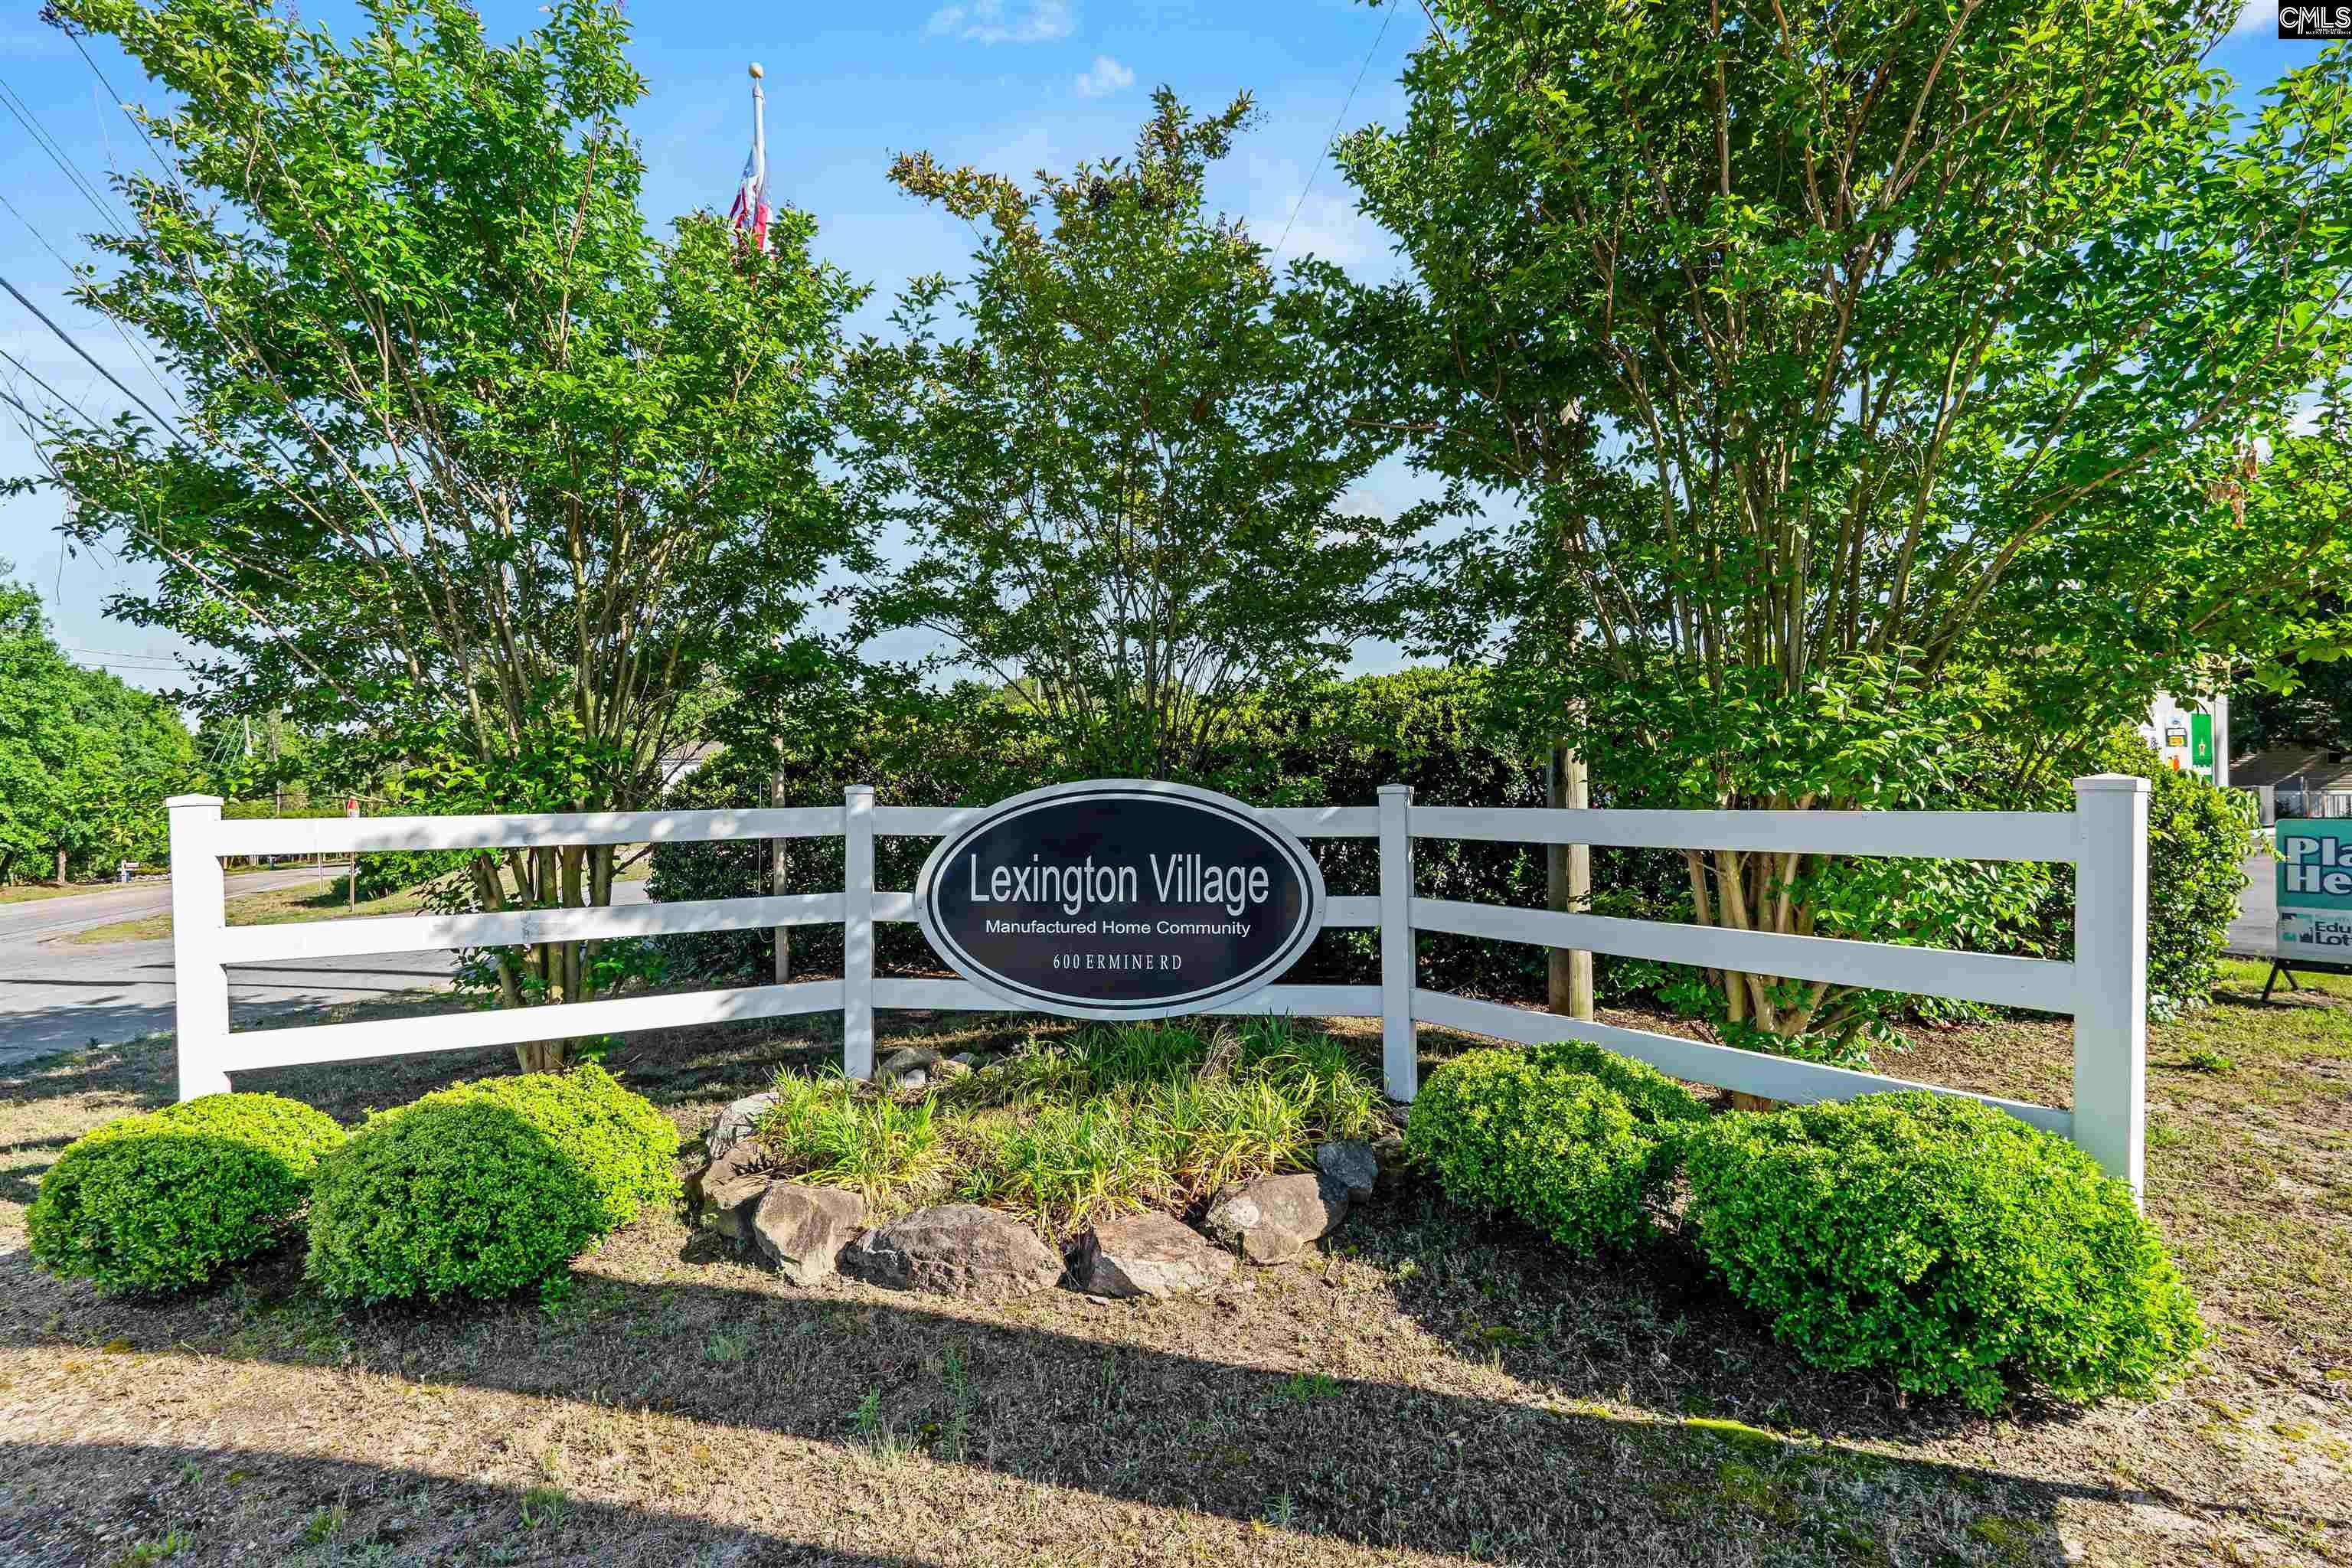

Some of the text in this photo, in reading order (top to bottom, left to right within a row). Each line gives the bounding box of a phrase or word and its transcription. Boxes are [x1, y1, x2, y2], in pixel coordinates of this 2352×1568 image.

[970, 853, 1269, 916] Lexington Village
[2285, 864, 2352, 894] He
[985, 920, 1251, 938] Manufactured Home Community
[1053, 954, 1182, 970] 600 ERMINE RD
